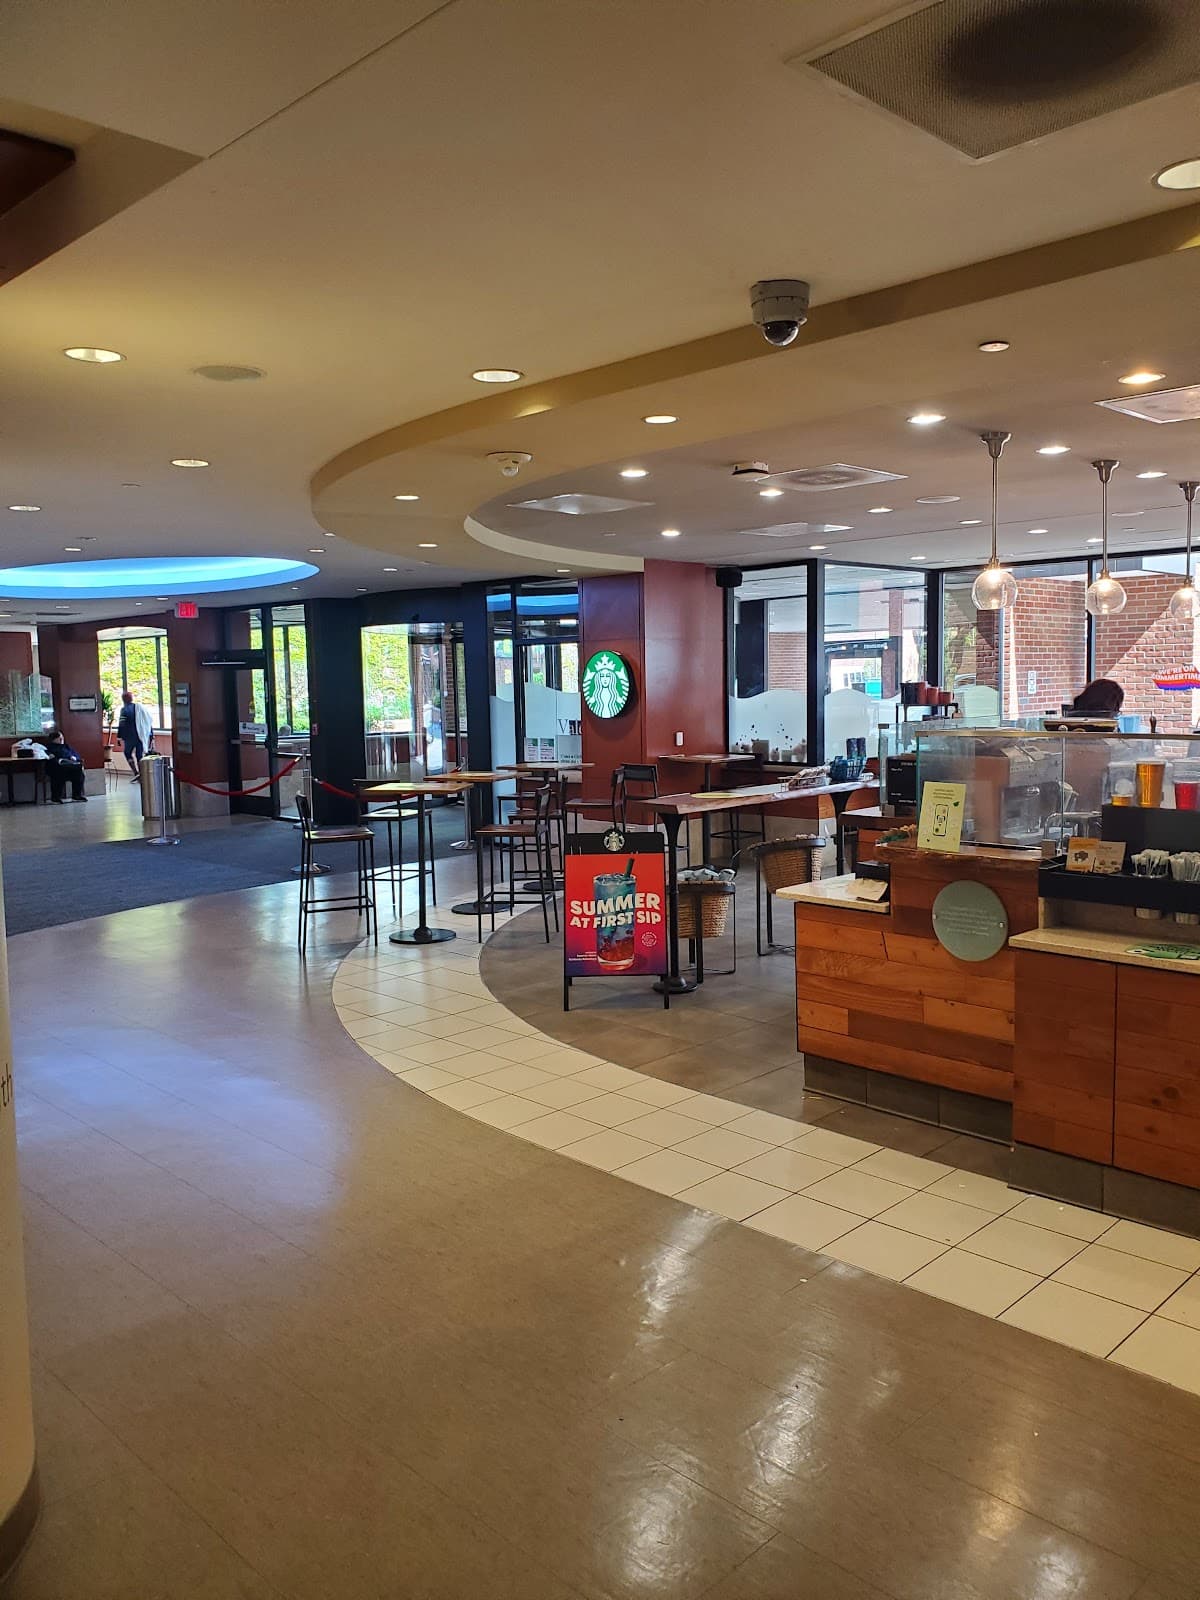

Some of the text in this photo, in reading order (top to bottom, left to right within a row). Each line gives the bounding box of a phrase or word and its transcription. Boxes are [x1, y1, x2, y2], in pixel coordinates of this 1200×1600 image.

[570, 893, 660, 915] SUMMER
[570, 911, 661, 928] AT FIRST SIP
